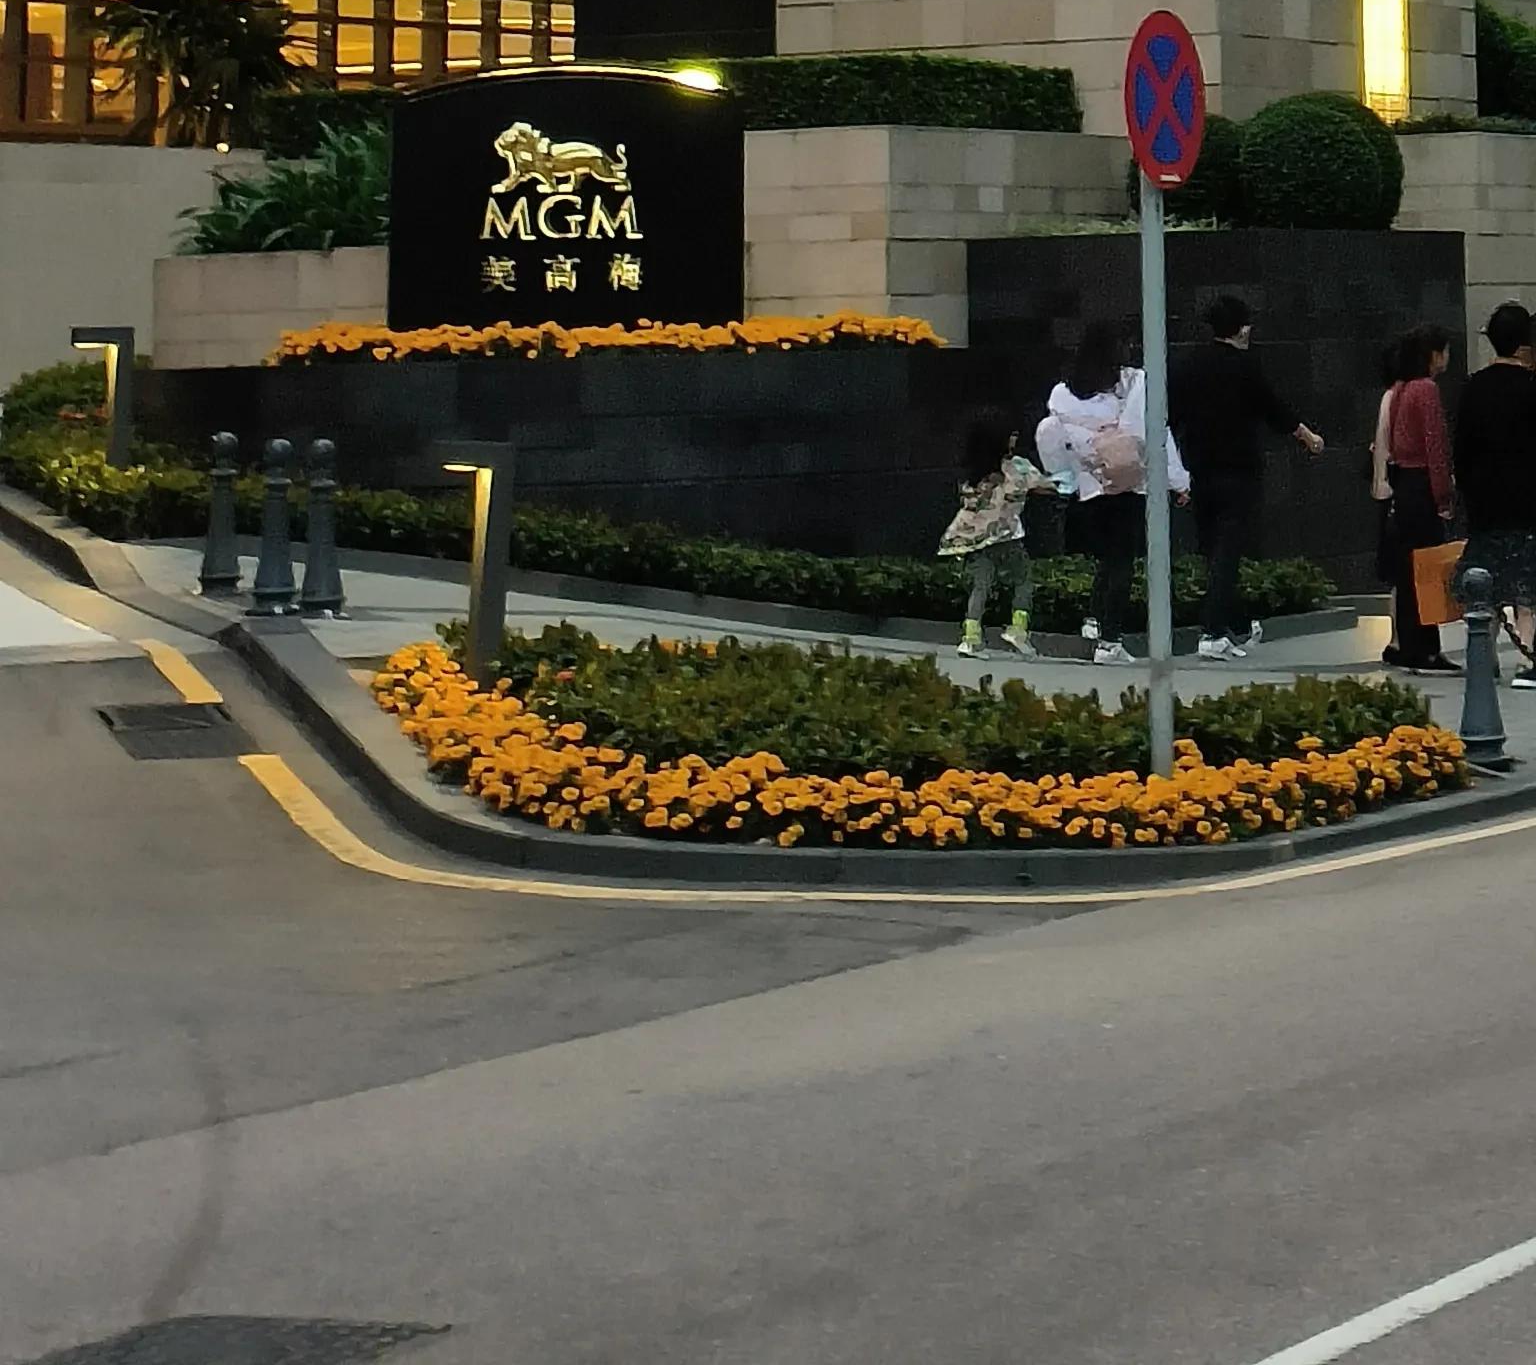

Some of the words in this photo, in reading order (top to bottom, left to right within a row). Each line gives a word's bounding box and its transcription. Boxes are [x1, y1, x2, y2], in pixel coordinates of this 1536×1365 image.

[479, 194, 644, 240] MGM
[480, 253, 643, 292] 美高梅
